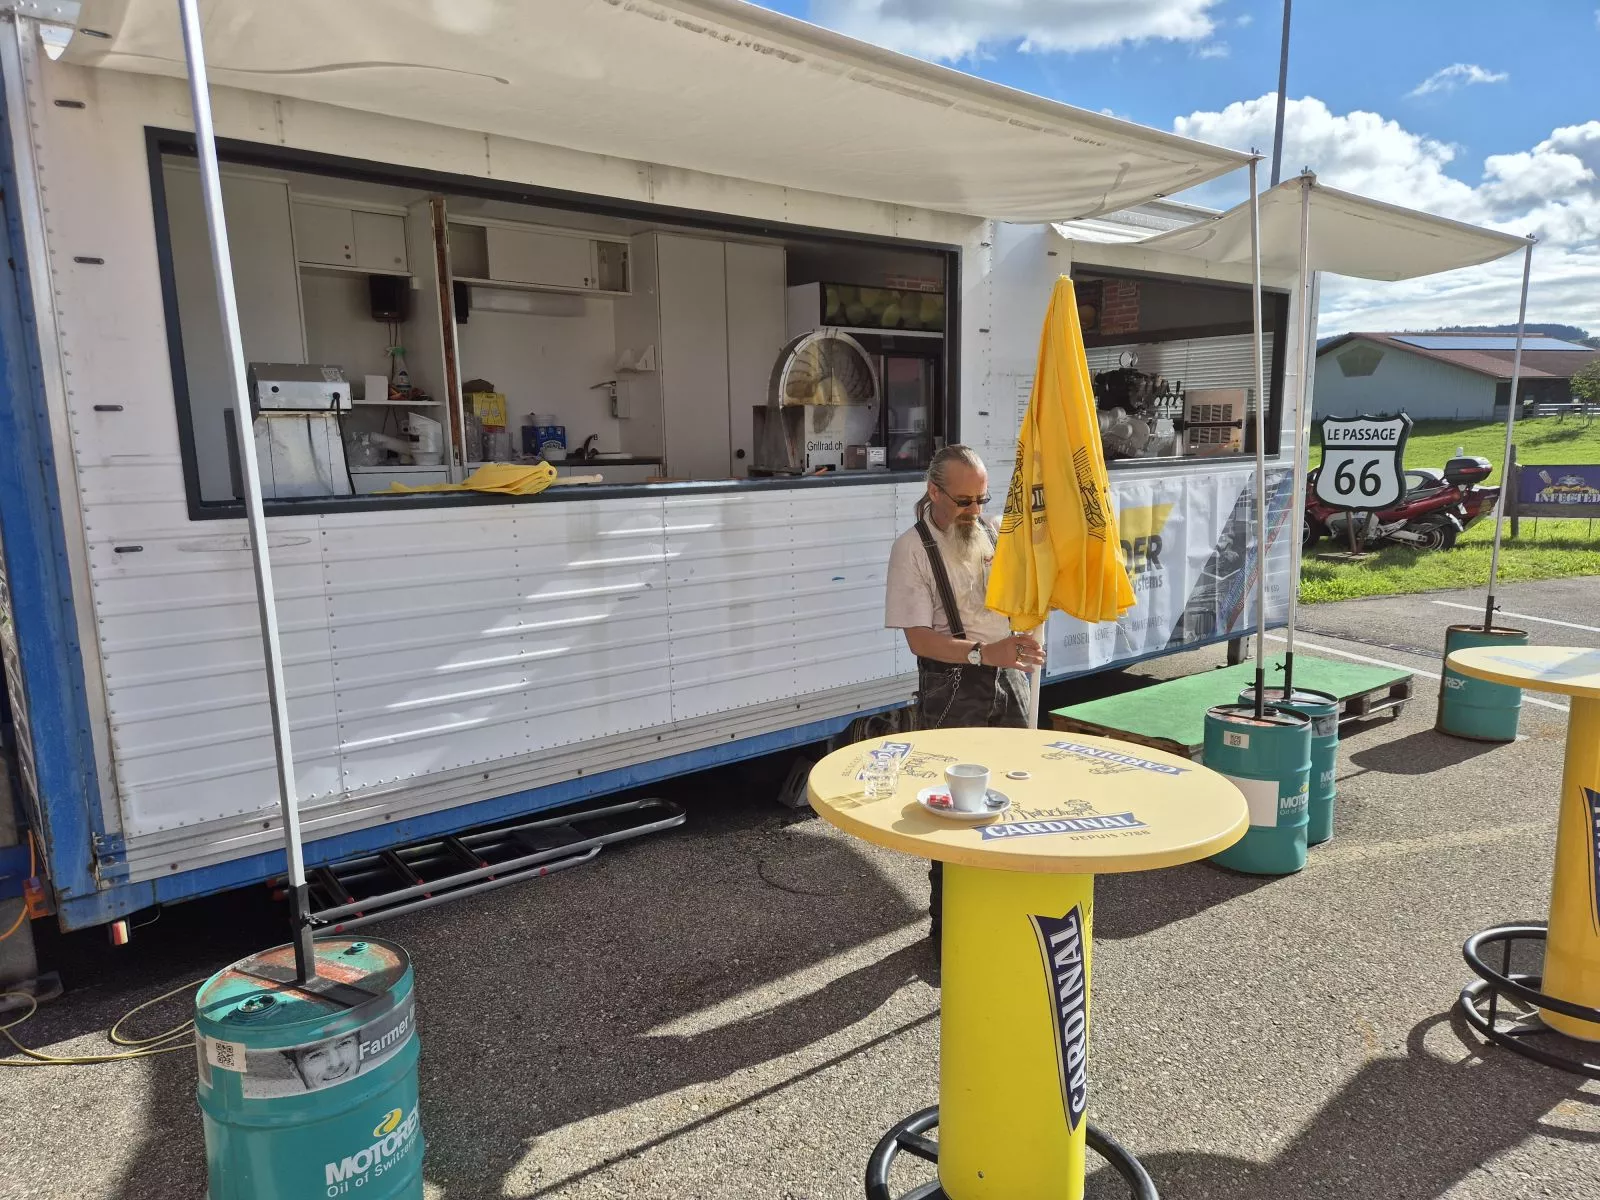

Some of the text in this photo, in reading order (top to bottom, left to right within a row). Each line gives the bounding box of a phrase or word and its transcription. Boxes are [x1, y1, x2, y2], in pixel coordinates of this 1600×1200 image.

[807, 441, 843, 452] Grillrad.ch
[1327, 428, 1396, 441] LE PASSAGE
[1334, 458, 1382, 497] 66
[1130, 575, 1164, 595] ystems
[1055, 741, 1178, 773] CARDINAL
[985, 815, 1139, 838] CARDINAL
[1070, 832, 1119, 842] DEPUIS
[1050, 914, 1087, 1114] CARDINAL
[359, 1015, 409, 1060] Farmer
[327, 1182, 349, 1198] Oil
[355, 1171, 369, 1187] of
